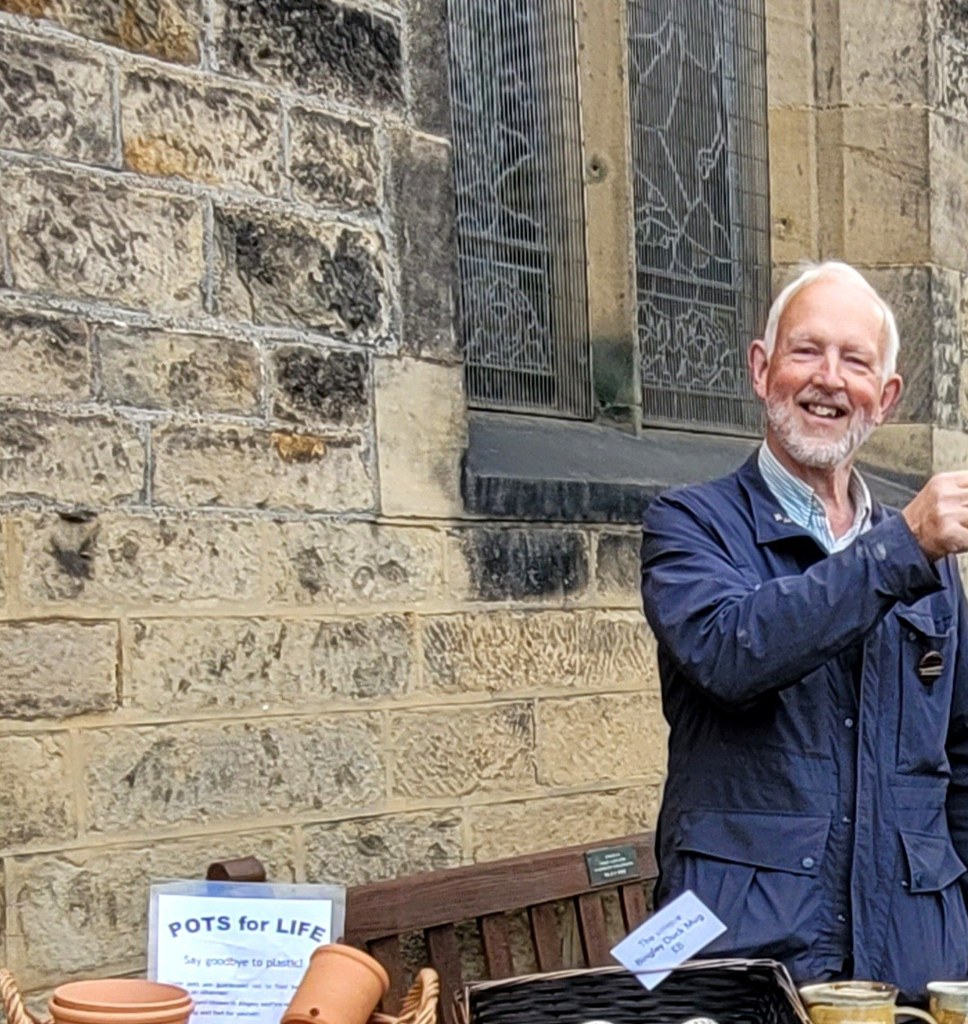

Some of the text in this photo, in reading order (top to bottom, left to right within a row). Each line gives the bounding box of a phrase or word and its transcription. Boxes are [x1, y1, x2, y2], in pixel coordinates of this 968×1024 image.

[168, 916, 326, 943] POTS for LIFE
[252, 958, 263, 967] to
